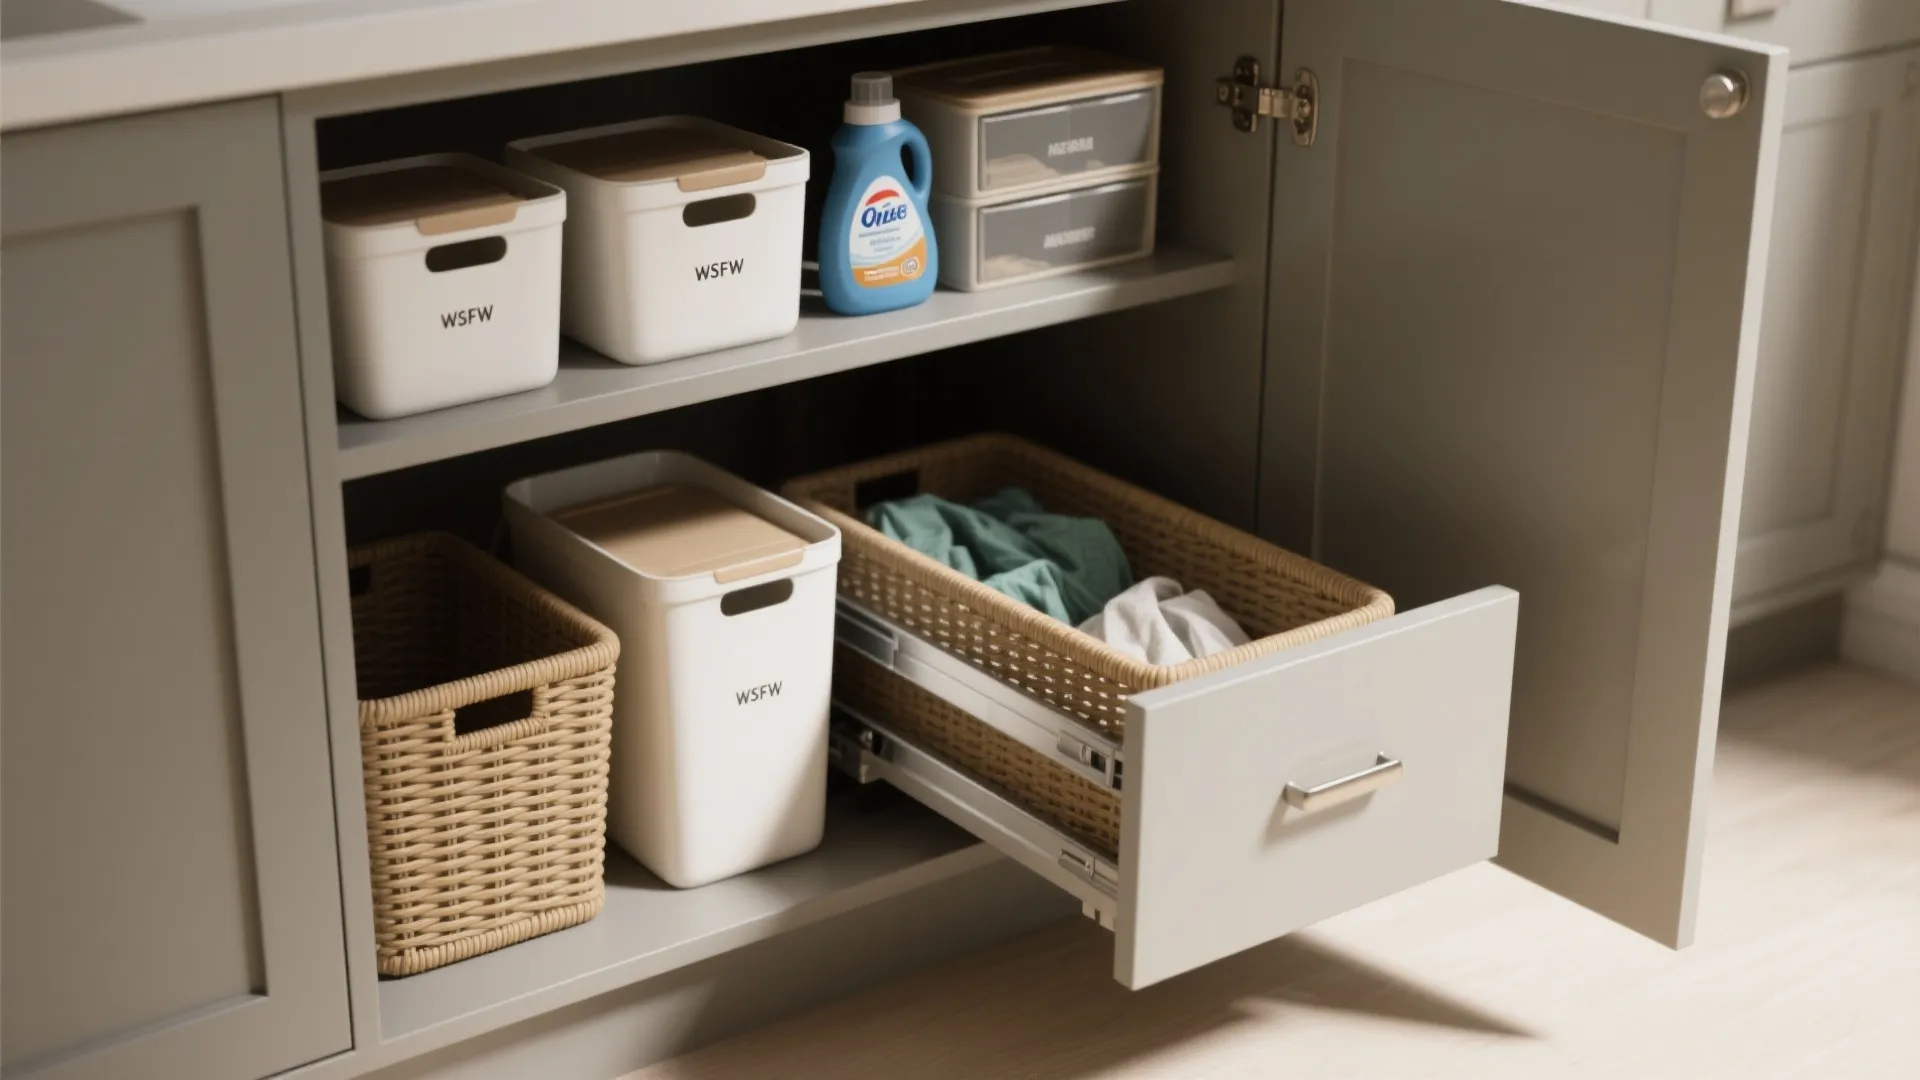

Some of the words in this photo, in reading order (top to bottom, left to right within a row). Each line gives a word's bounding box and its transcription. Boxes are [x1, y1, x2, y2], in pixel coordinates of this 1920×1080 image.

[694, 258, 744, 281] WSFW
[440, 304, 494, 329] WSFW
[735, 680, 783, 706] WSFW
